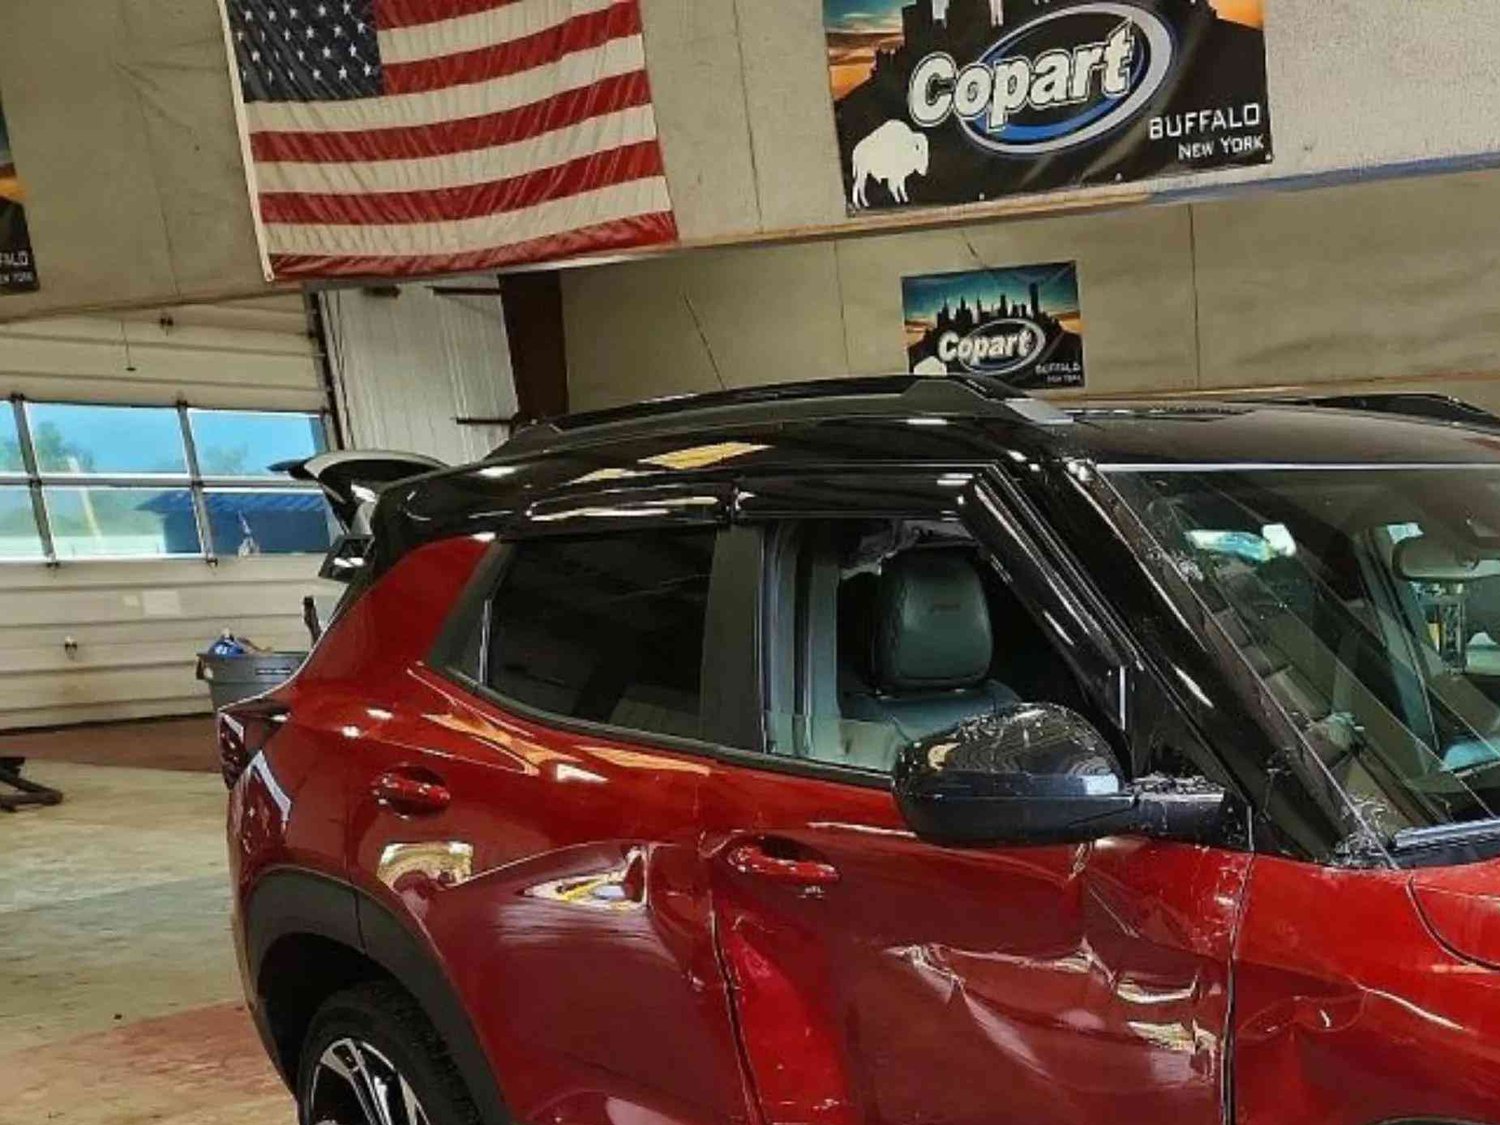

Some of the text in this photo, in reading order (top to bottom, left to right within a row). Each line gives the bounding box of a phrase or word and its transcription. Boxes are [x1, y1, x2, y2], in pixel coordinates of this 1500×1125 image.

[908, 16, 1136, 132] Copart
[1149, 103, 1260, 139] BUFFALO
[1178, 134, 1264, 160] NEW YORK
[938, 327, 1032, 367] Copart
